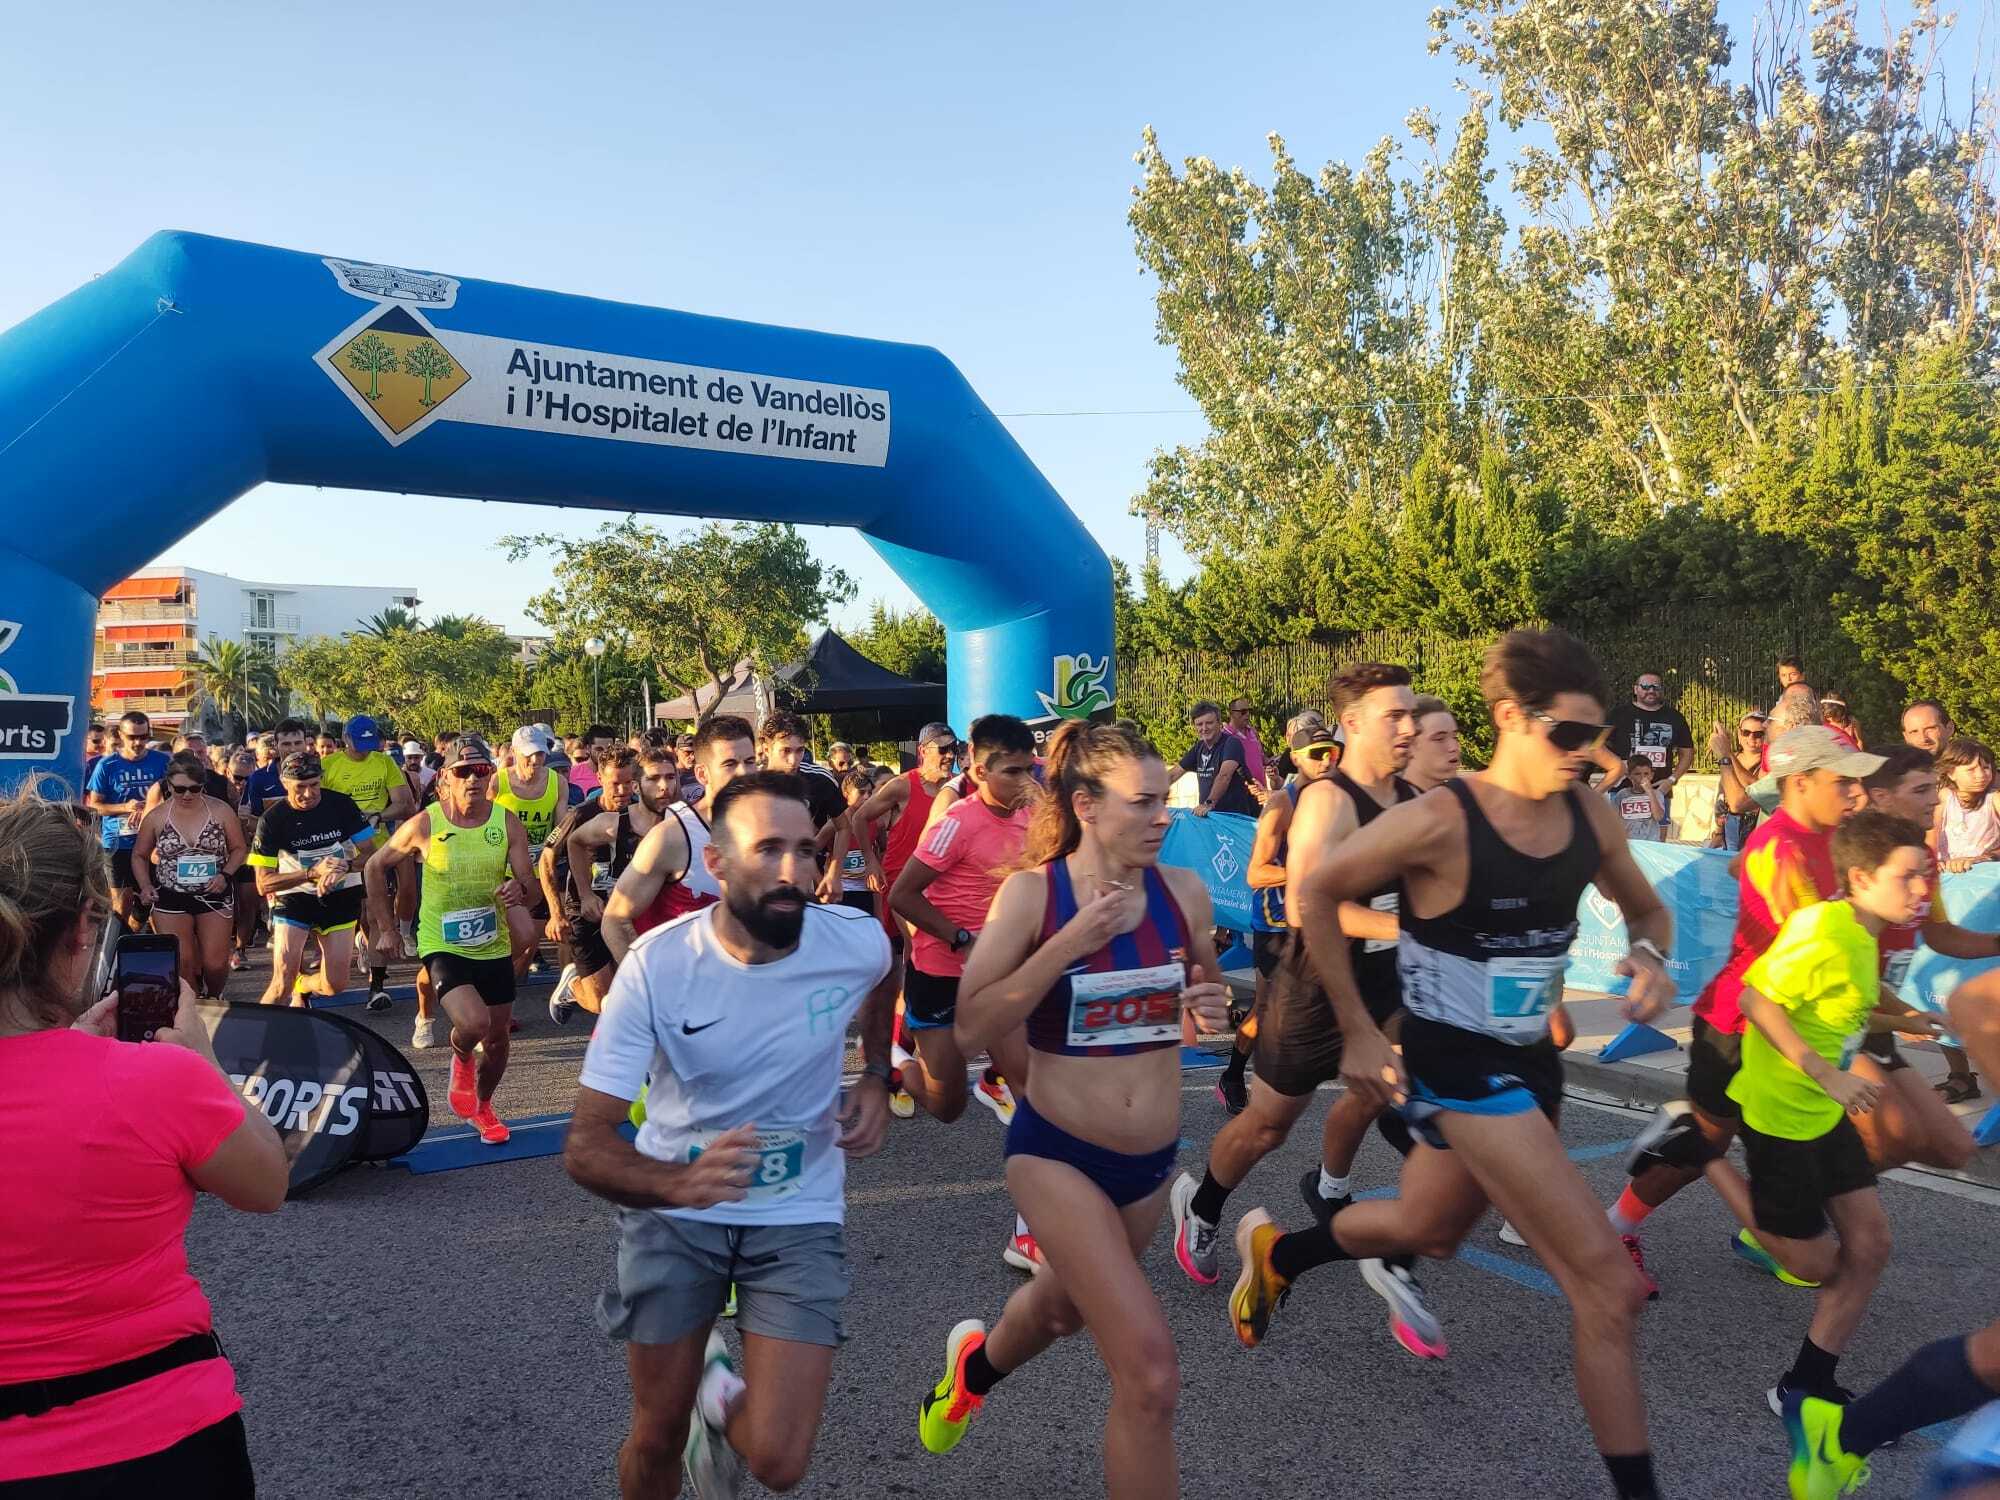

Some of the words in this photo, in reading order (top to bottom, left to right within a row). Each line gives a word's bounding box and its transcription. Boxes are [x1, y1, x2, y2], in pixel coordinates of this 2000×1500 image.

[507, 348, 699, 399] Ajuntament
[707, 377, 744, 404] de
[751, 381, 886, 421] Vandellòs
[507, 386, 515, 414] i
[716, 414, 753, 442] de
[1625, 804, 1650, 813] 543
[187, 863, 208, 877] 42
[458, 918, 486, 939] 82
[1664, 958, 1690, 970] nfant
[1924, 990, 1947, 1004] Van
[1084, 991, 1174, 1028] 205
